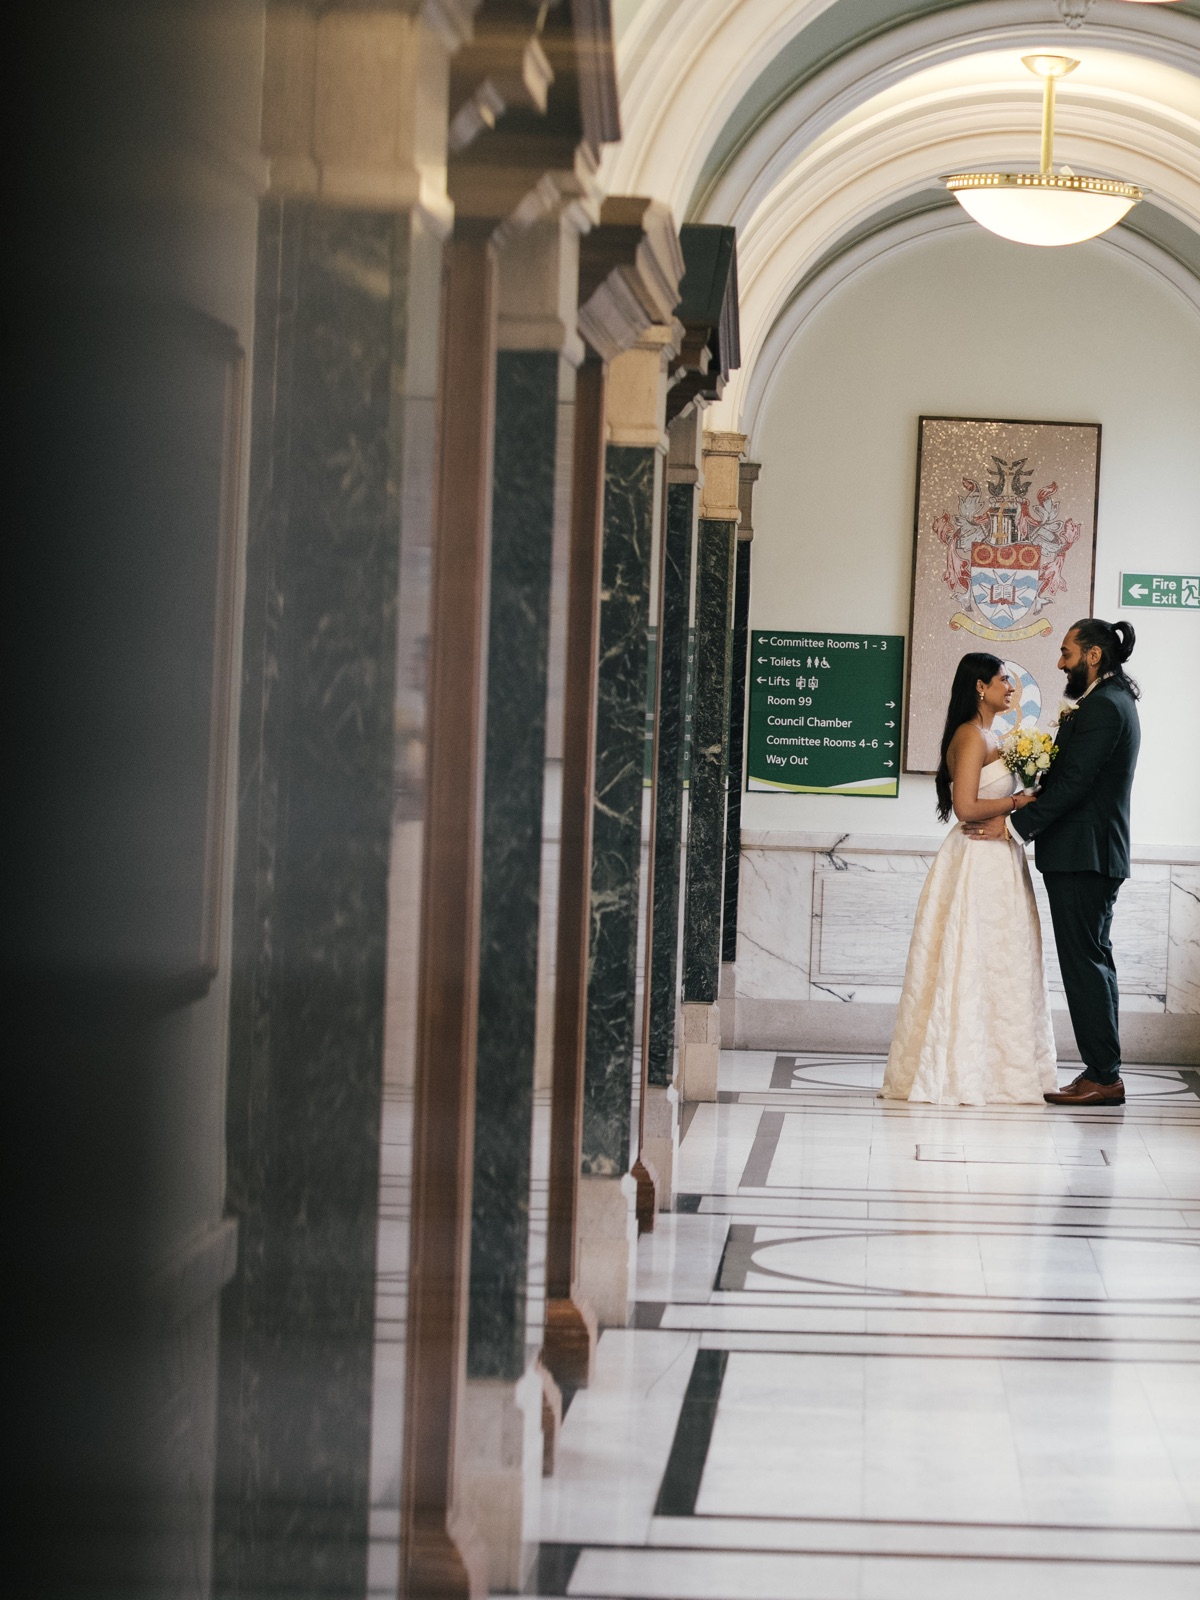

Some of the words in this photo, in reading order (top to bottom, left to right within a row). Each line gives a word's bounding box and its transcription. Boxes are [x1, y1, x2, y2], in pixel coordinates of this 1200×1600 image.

[1152, 578, 1177, 590] Fire
[1152, 593, 1177, 605] Exit
[769, 636, 825, 648] Committee
[827, 639, 860, 650] Rooms
[863, 640, 868, 650] 1
[880, 641, 887, 651] 3
[769, 656, 801, 667] Toilets
[768, 676, 791, 687] Lifts
[767, 695, 796, 706] Room
[798, 696, 813, 706] 99
[767, 715, 805, 727] Council
[806, 717, 853, 728] Chamber
[766, 735, 821, 746] Committee
[823, 737, 857, 748] Rooms
[858, 738, 879, 749] 4-6
[766, 754, 788, 767] Way
[789, 755, 809, 766] Out
